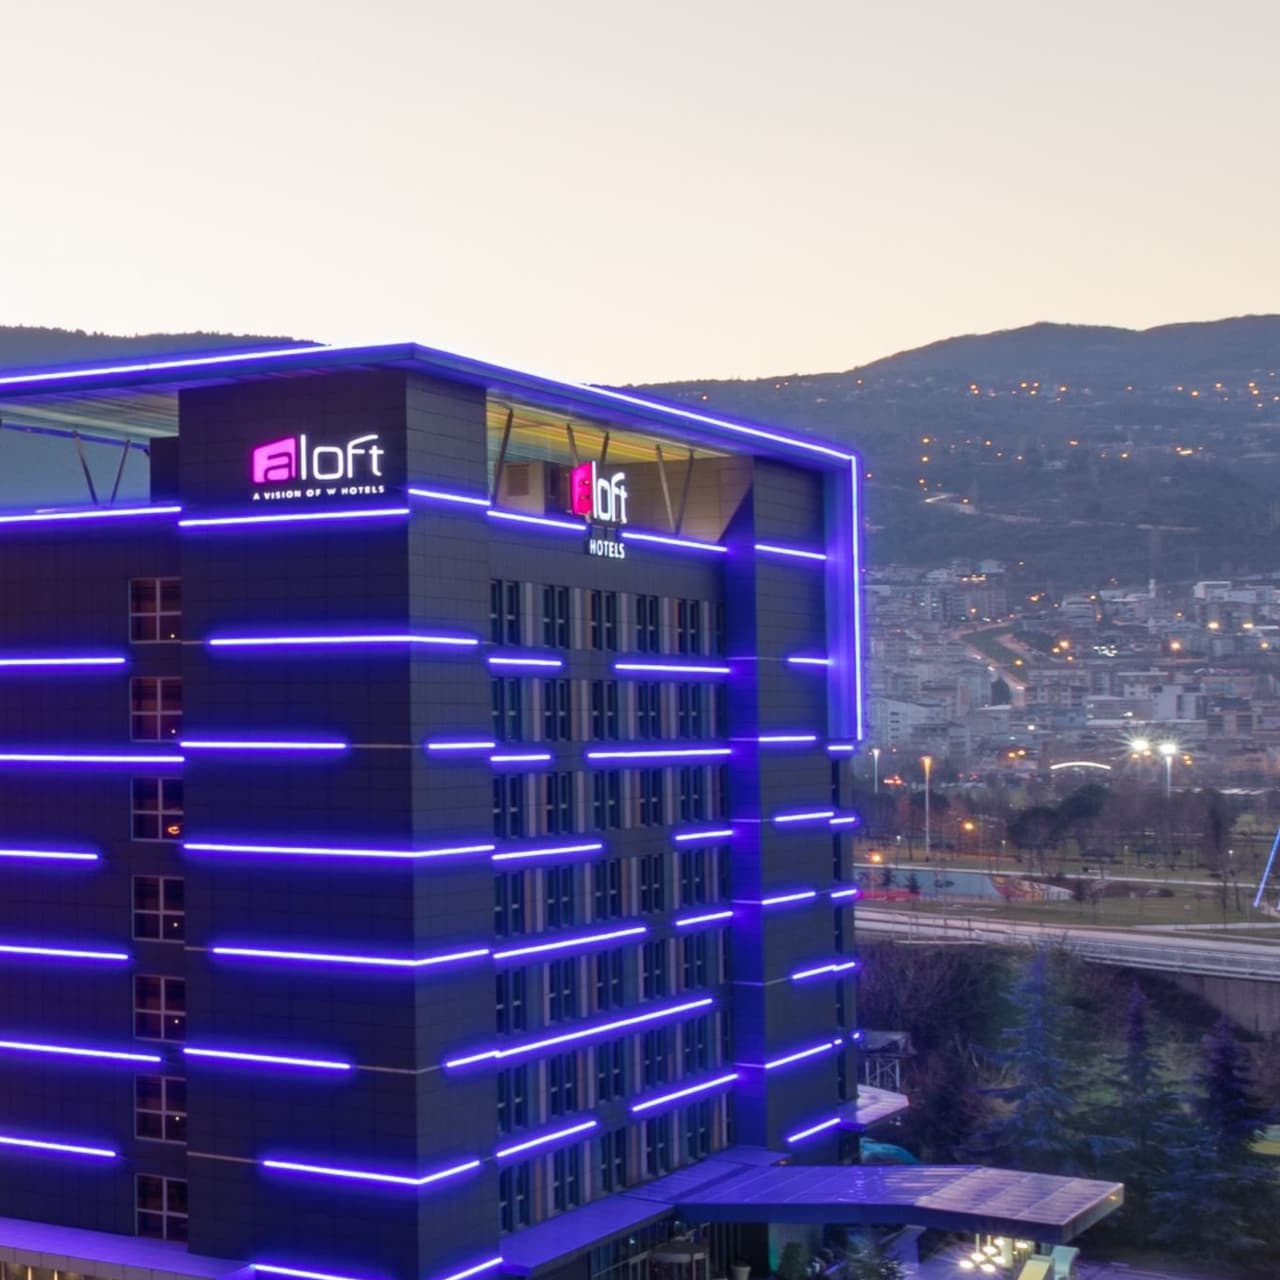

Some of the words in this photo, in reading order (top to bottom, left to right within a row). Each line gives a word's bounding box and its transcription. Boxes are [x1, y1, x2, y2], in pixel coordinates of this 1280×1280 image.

[253, 434, 384, 483] aloft
[253, 492, 260, 501] A
[264, 489, 301, 500] VISION
[306, 488, 321, 497] OF
[341, 485, 385, 495] HOTELS
[589, 539, 625, 559] HOTELS
